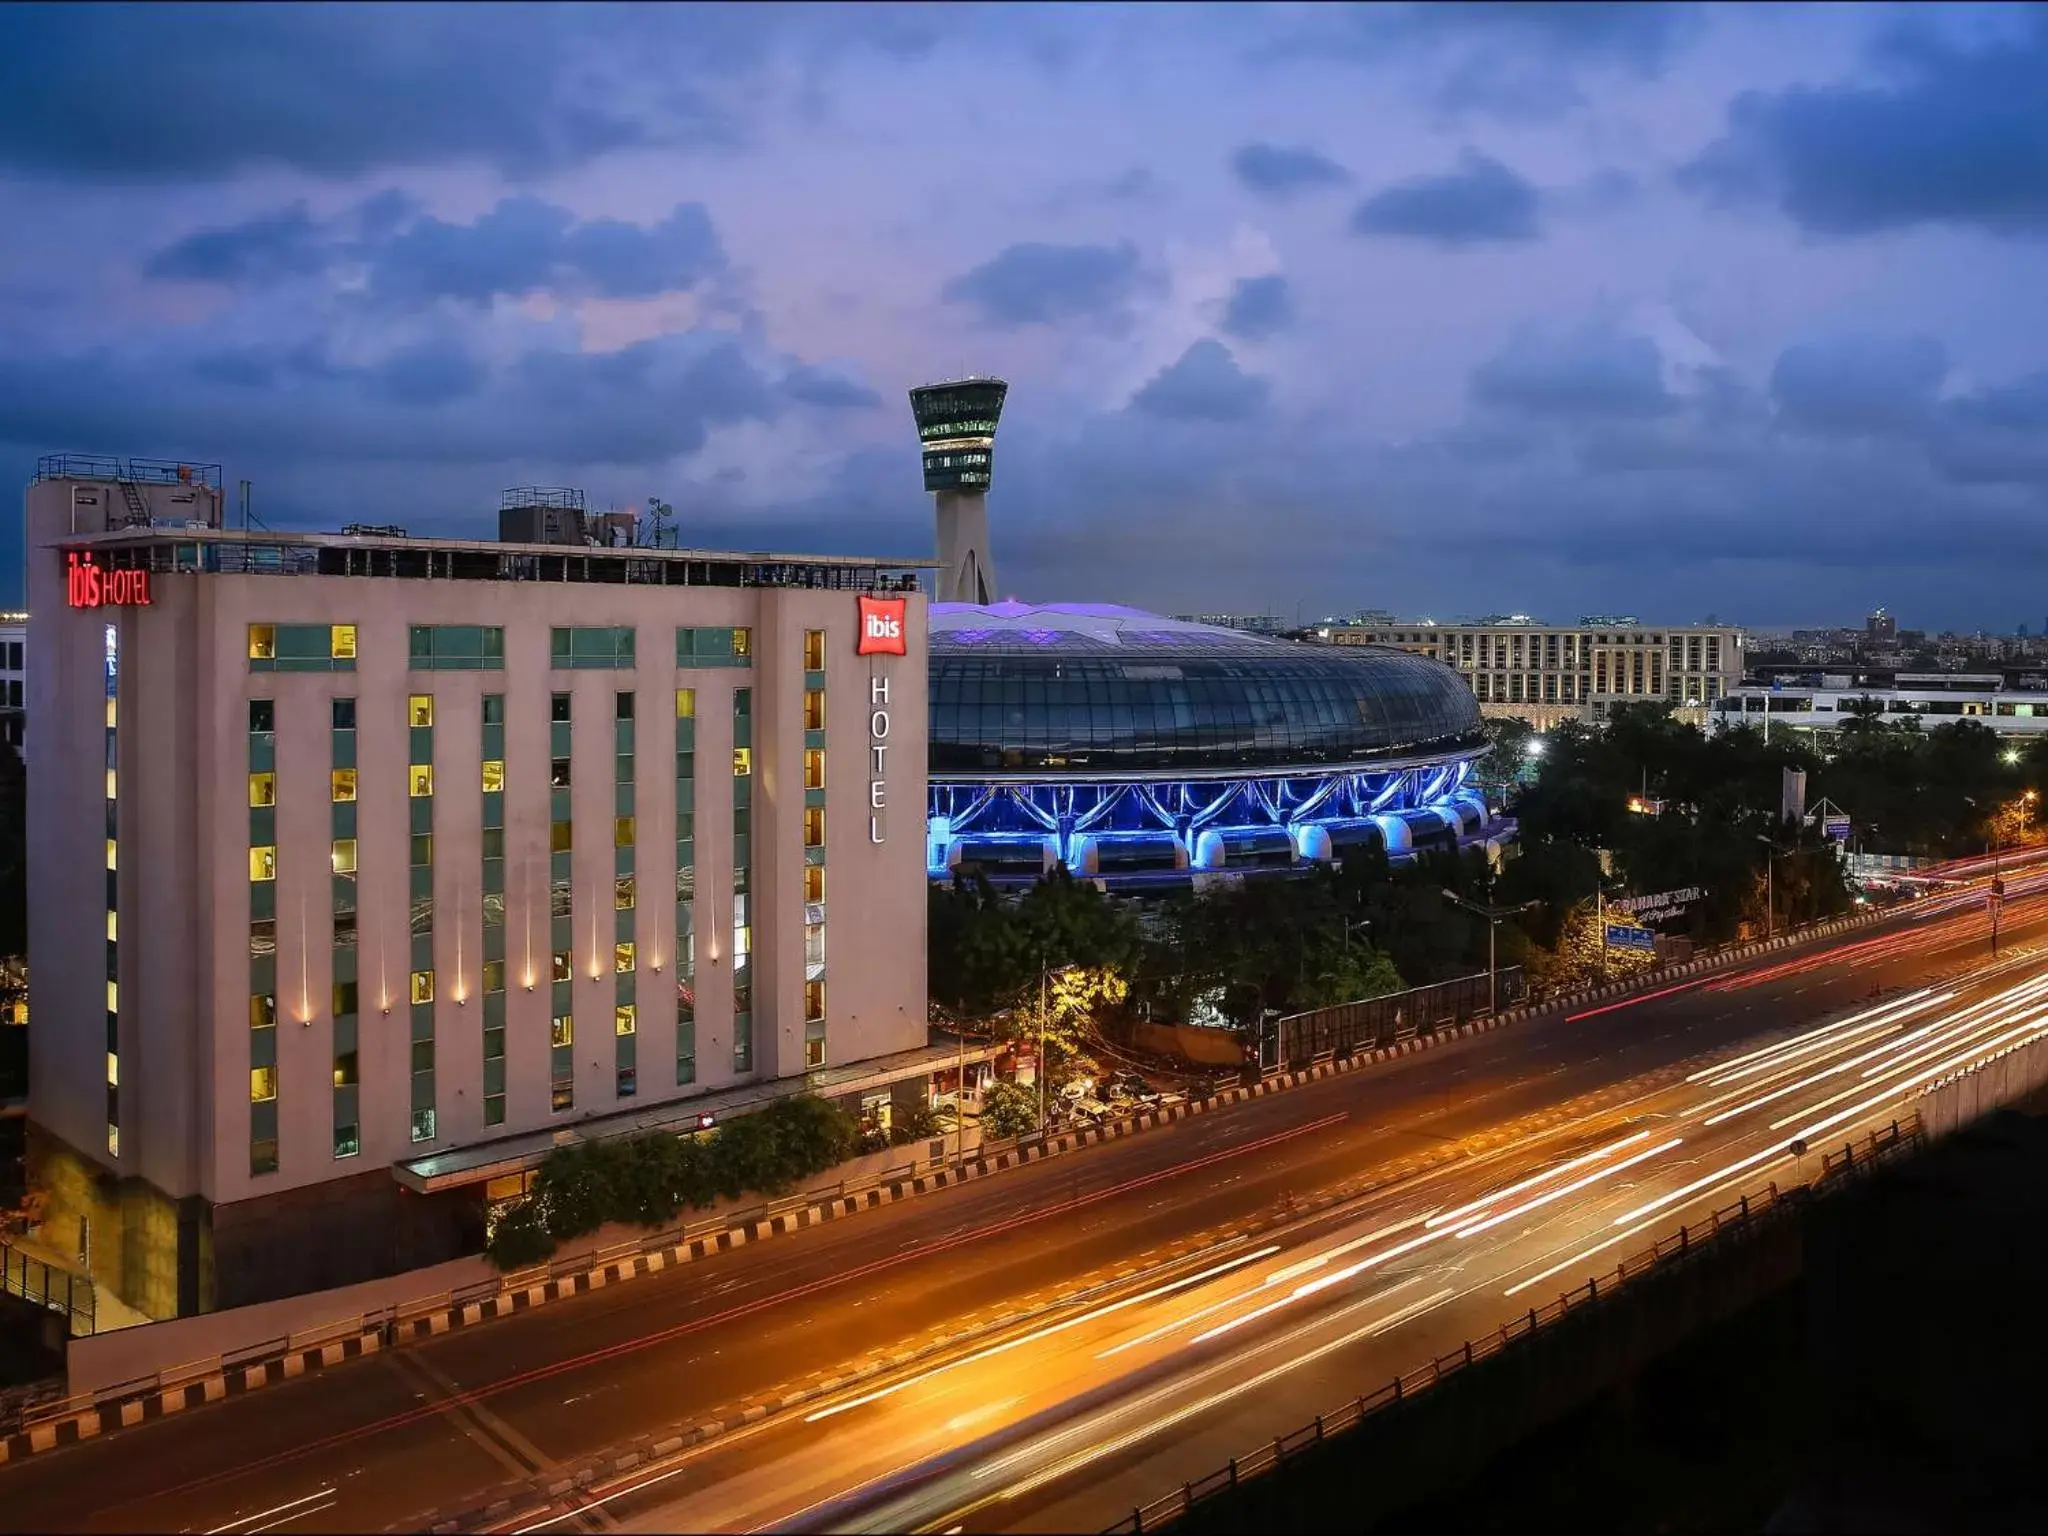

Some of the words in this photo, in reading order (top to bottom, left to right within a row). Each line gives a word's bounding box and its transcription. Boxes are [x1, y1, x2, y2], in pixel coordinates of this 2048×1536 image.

[68, 551, 101, 607] ibis
[103, 569, 150, 605] HOTEL
[866, 615, 900, 638] ibis
[872, 677, 889, 843] HOTEL
[1673, 887, 1700, 903] STAR
